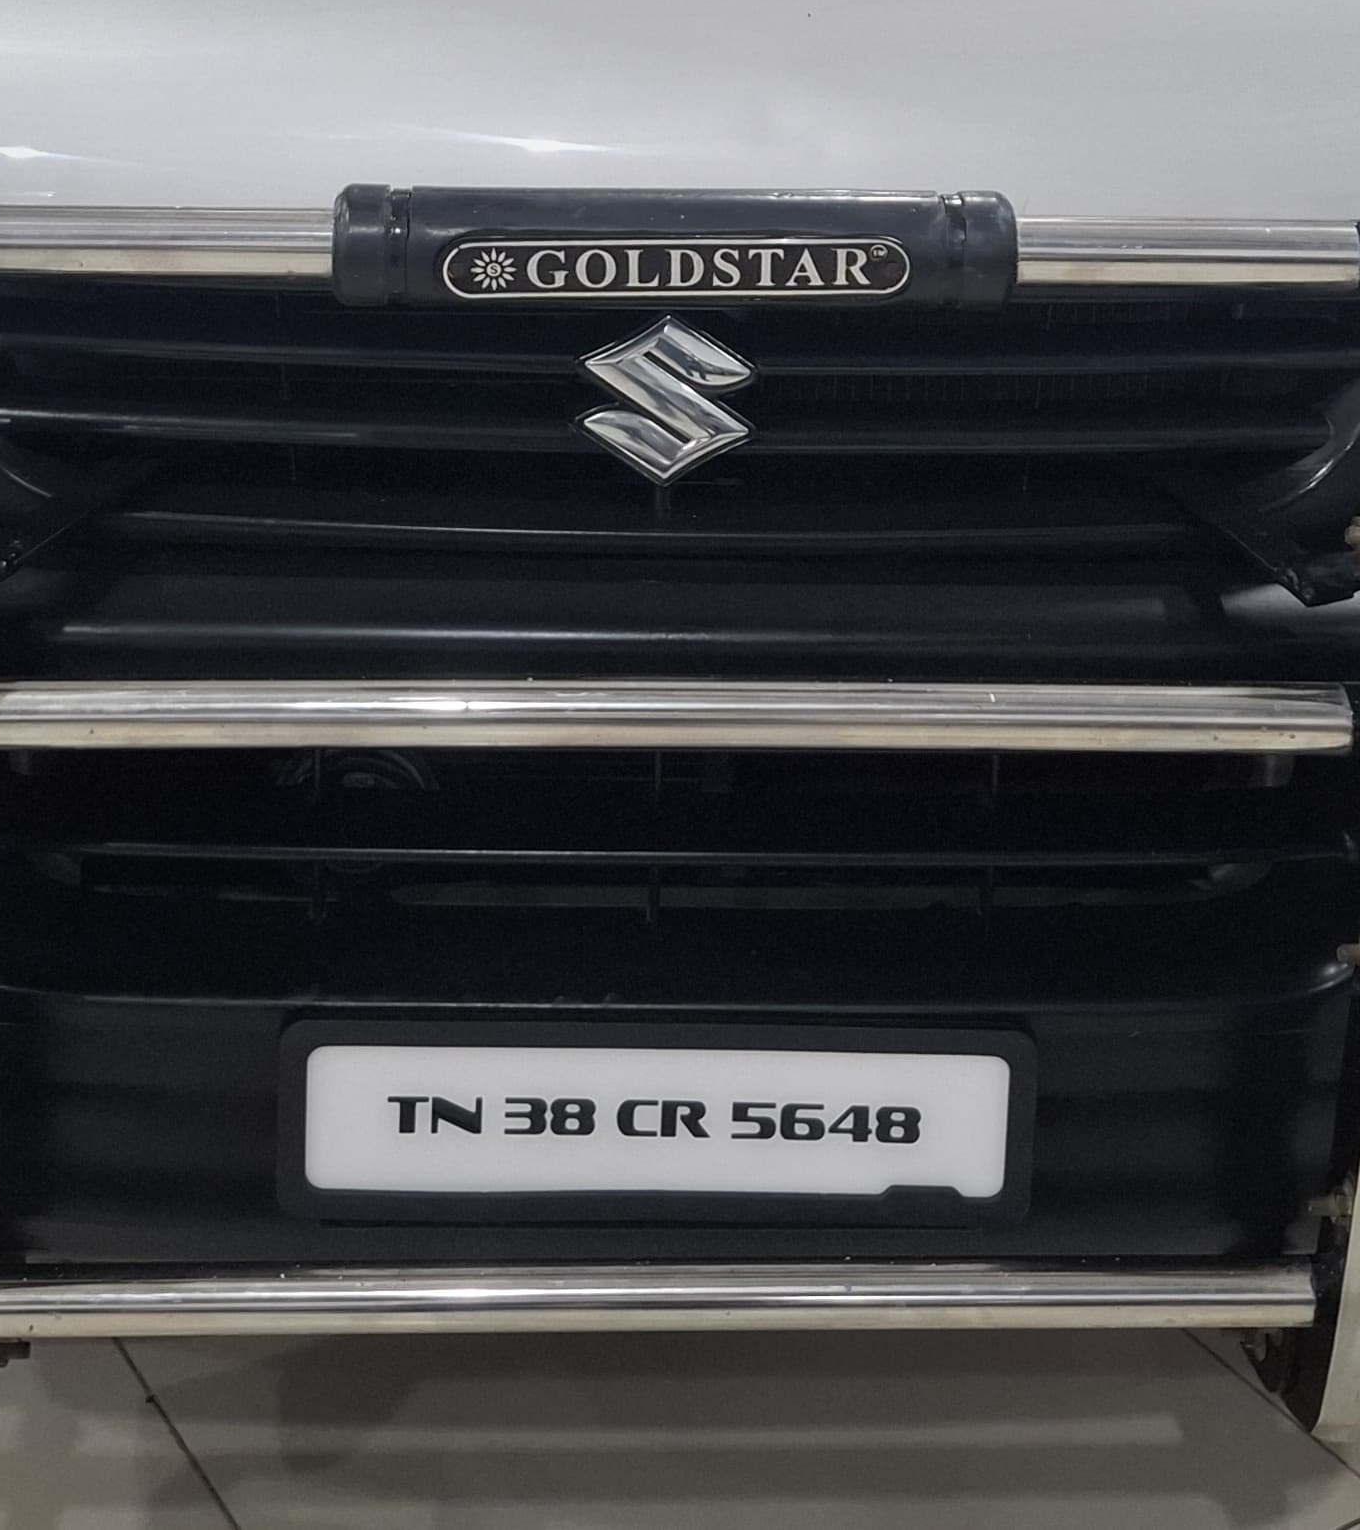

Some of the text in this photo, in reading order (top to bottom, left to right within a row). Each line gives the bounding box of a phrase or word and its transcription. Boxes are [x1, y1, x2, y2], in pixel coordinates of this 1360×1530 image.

[526, 248, 871, 289] GOLDSTAR
[387, 1096, 922, 1144] TN 38 CR 5648
